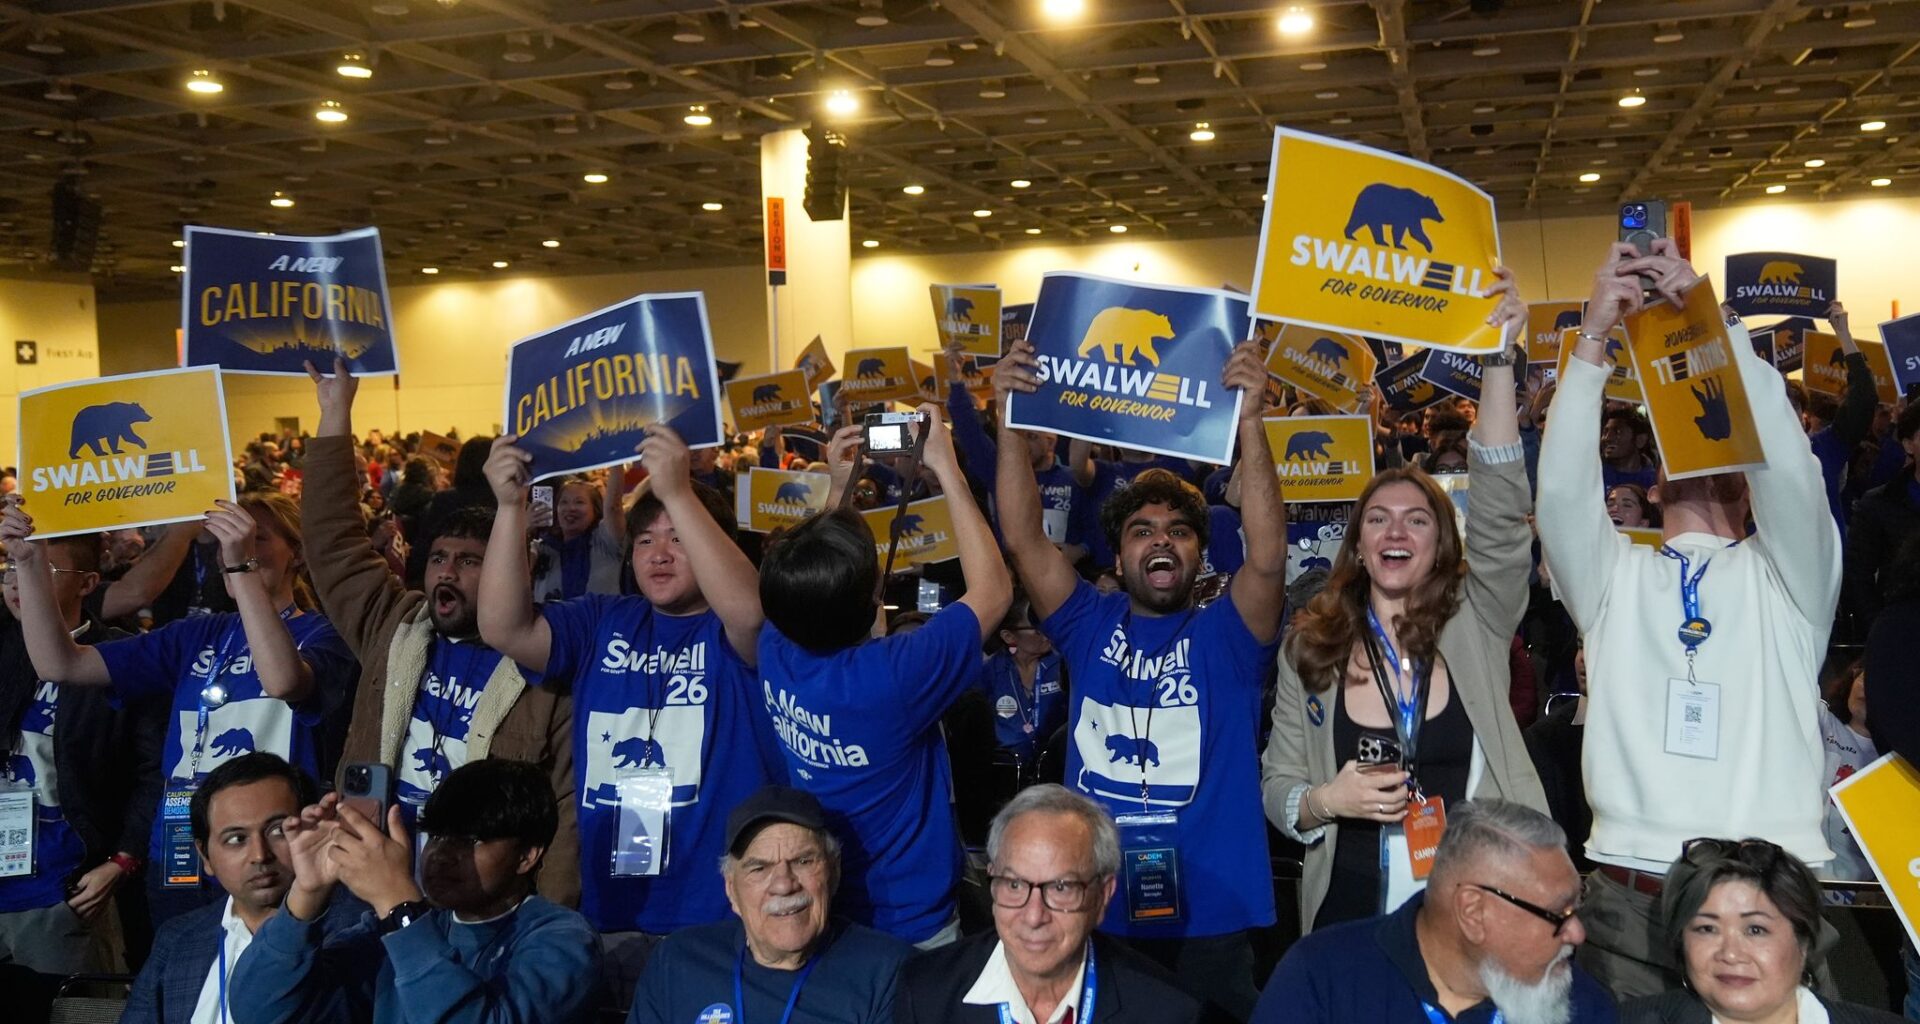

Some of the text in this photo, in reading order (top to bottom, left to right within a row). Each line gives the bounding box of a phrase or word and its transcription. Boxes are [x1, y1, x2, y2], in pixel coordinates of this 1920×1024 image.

[269, 255, 344, 273] A NEW
[1290, 235, 1485, 298] SWALWELL
[200, 281, 385, 331] CALIFORNIA
[1321, 278, 1448, 313] FOR GOVERNOR
[1737, 284, 1826, 301] SWALWELL
[564, 322, 626, 359] A NEW
[1283, 347, 1358, 393] SWALWELL
[1441, 352, 1483, 379] SWAL
[516, 353, 699, 437] CALIFORNIA
[844, 377, 906, 391] SWALWELL
[1035, 355, 1211, 408] SWALWELL
[1387, 373, 1422, 396] LWELL
[740, 400, 803, 417] SWALWELL
[1059, 391, 1176, 422] FOR GOVERNOR
[32, 449, 206, 492] SWALWELL
[1277, 460, 1360, 476] WALWELL
[64, 480, 176, 506] FOR GOVERNOR
[1042, 485, 1071, 496] well
[1297, 477, 1344, 487] GOVERNOR
[758, 502, 820, 517] SWALWE
[1286, 503, 1352, 522] alwell
[1103, 629, 1190, 680] Swlwell
[764, 680, 830, 737] A New
[770, 715, 869, 767] alifornia
[165, 798, 192, 806] ASSEMB
